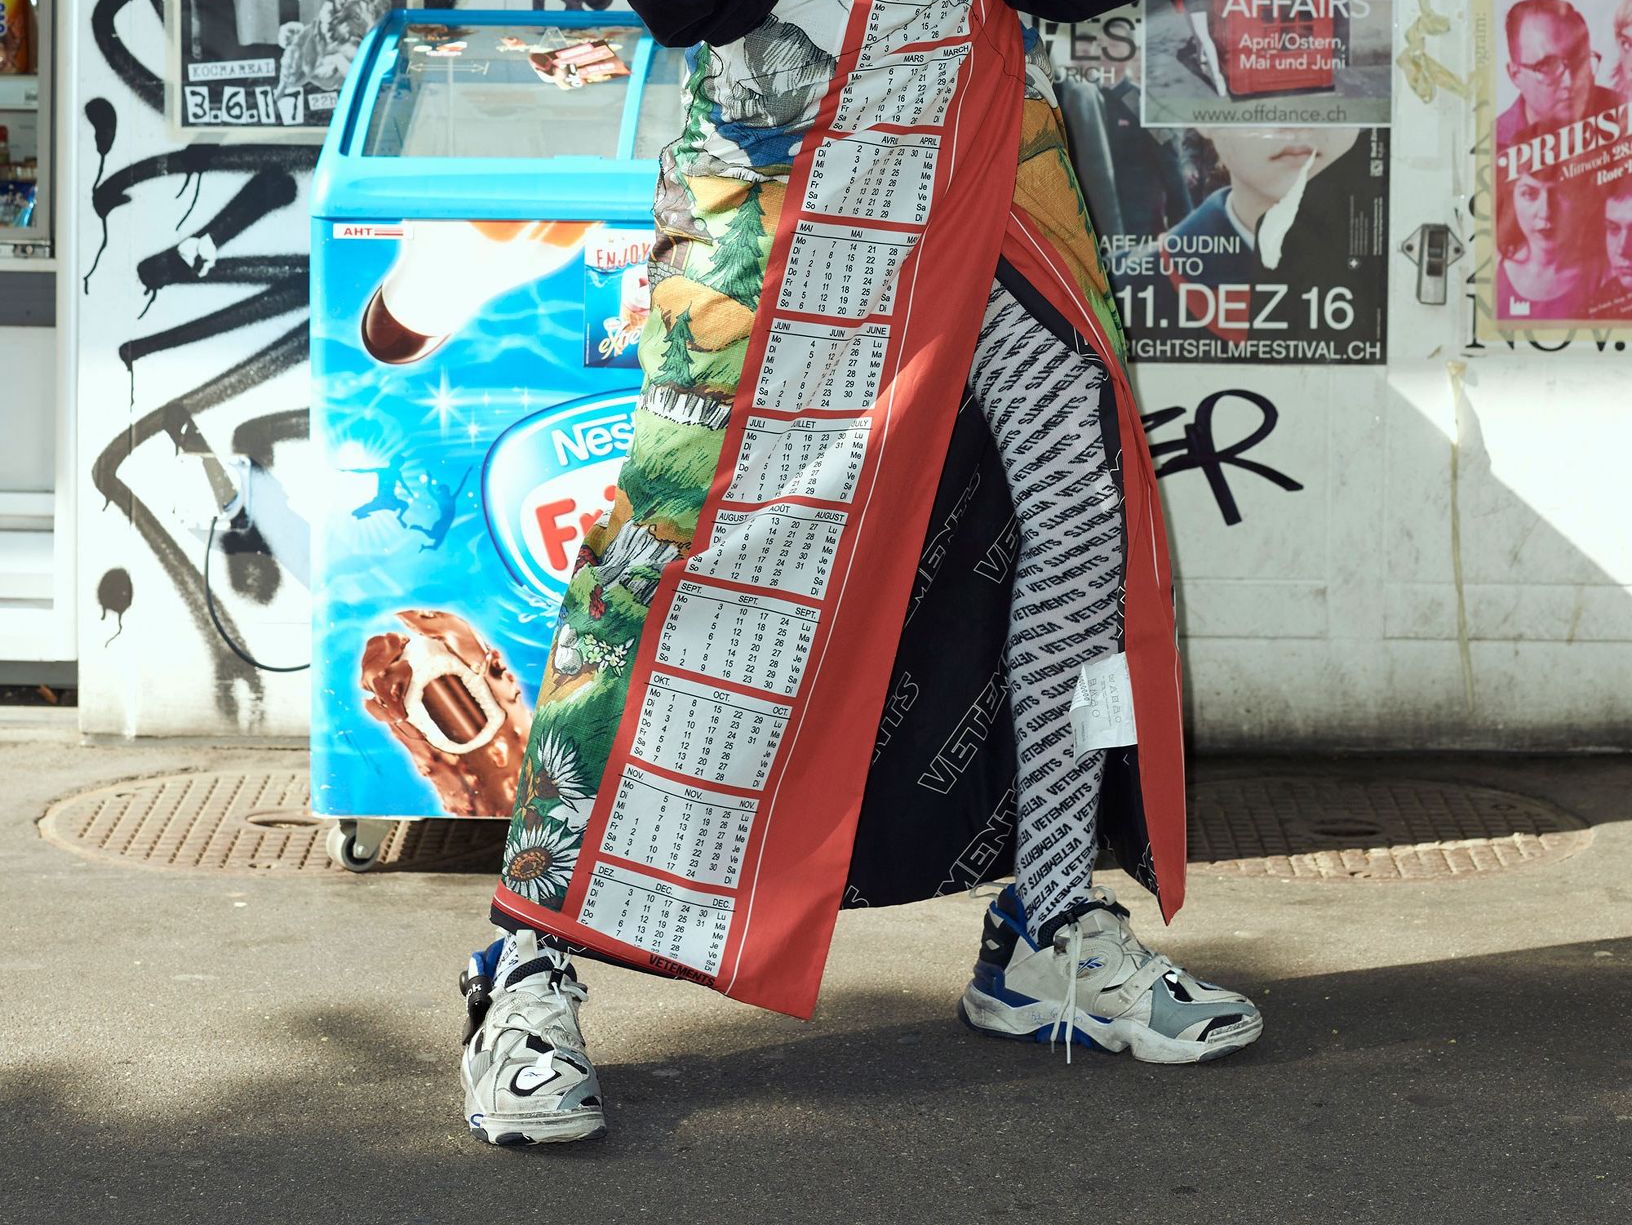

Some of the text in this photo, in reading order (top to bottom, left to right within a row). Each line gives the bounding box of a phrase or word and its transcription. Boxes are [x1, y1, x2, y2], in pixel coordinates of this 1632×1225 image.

[1239, 33, 1346, 53] April/Ostern,
[904, 46, 969, 63] MARS MARCH
[1239, 54, 1346, 70] Mai und Juni
[188, 87, 302, 123] 3.6.17
[1192, 104, 1347, 123] www.offdance.ch
[920, 136, 937, 145] APRIL
[344, 227, 373, 236] AHT
[800, 224, 863, 238] MAI MAI
[596, 244, 651, 270] ENJOY
[1159, 257, 1204, 276] UTO
[1117, 283, 1354, 330] 11. DEZ 16
[774, 323, 887, 338] JUNI JUIN JUNE
[719, 513, 749, 522] AUGUST
[815, 511, 845, 522] AUGUST
[681, 582, 817, 620] SEPT. SEPT. SEPT.
[653, 675, 789, 717] OKT. OCT. OCT.
[627, 767, 756, 810] NOV. NOV. NOV.
[598, 866, 731, 909] DEZ. DEC. DEC.
[650, 955, 717, 987] VETEMENTS
